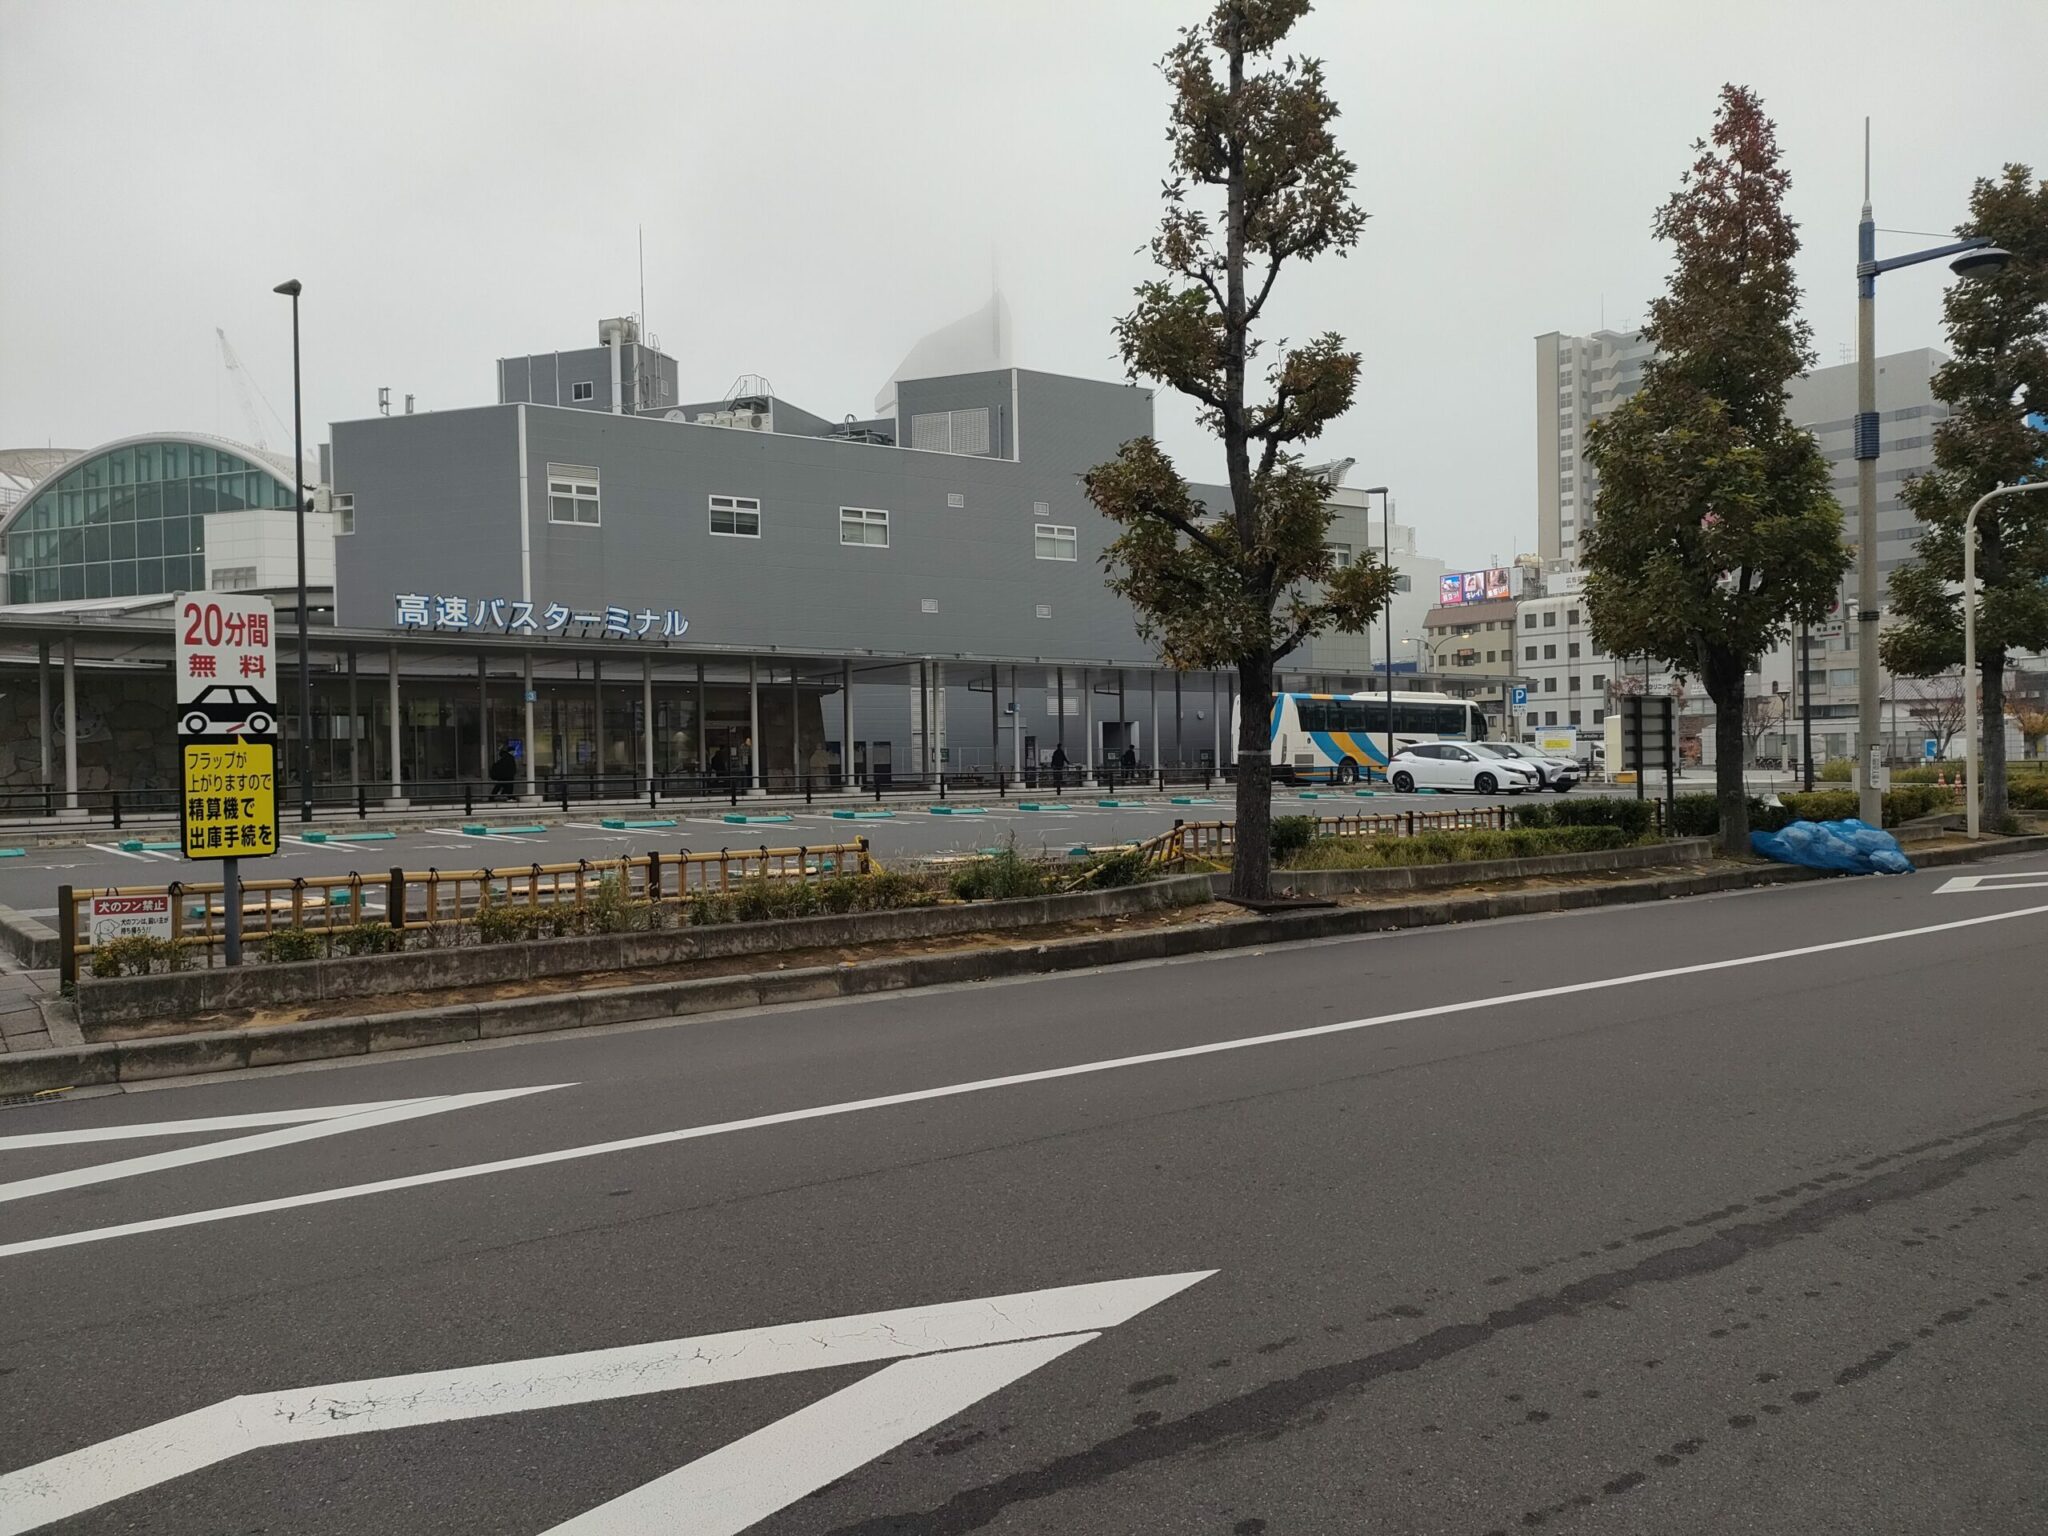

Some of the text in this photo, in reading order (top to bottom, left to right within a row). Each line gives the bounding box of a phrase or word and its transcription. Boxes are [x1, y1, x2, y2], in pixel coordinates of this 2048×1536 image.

[183, 602, 269, 647] 20分間
[395, 593, 690, 637] 高速バスターミナル
[1516, 689, 1525, 704] P
[188, 751, 247, 770] フラップが
[187, 773, 272, 793] 上がりますので
[188, 796, 255, 821] 精算機で
[190, 824, 272, 850] 出庫手続を
[98, 900, 165, 913] 犬のフン禁止
